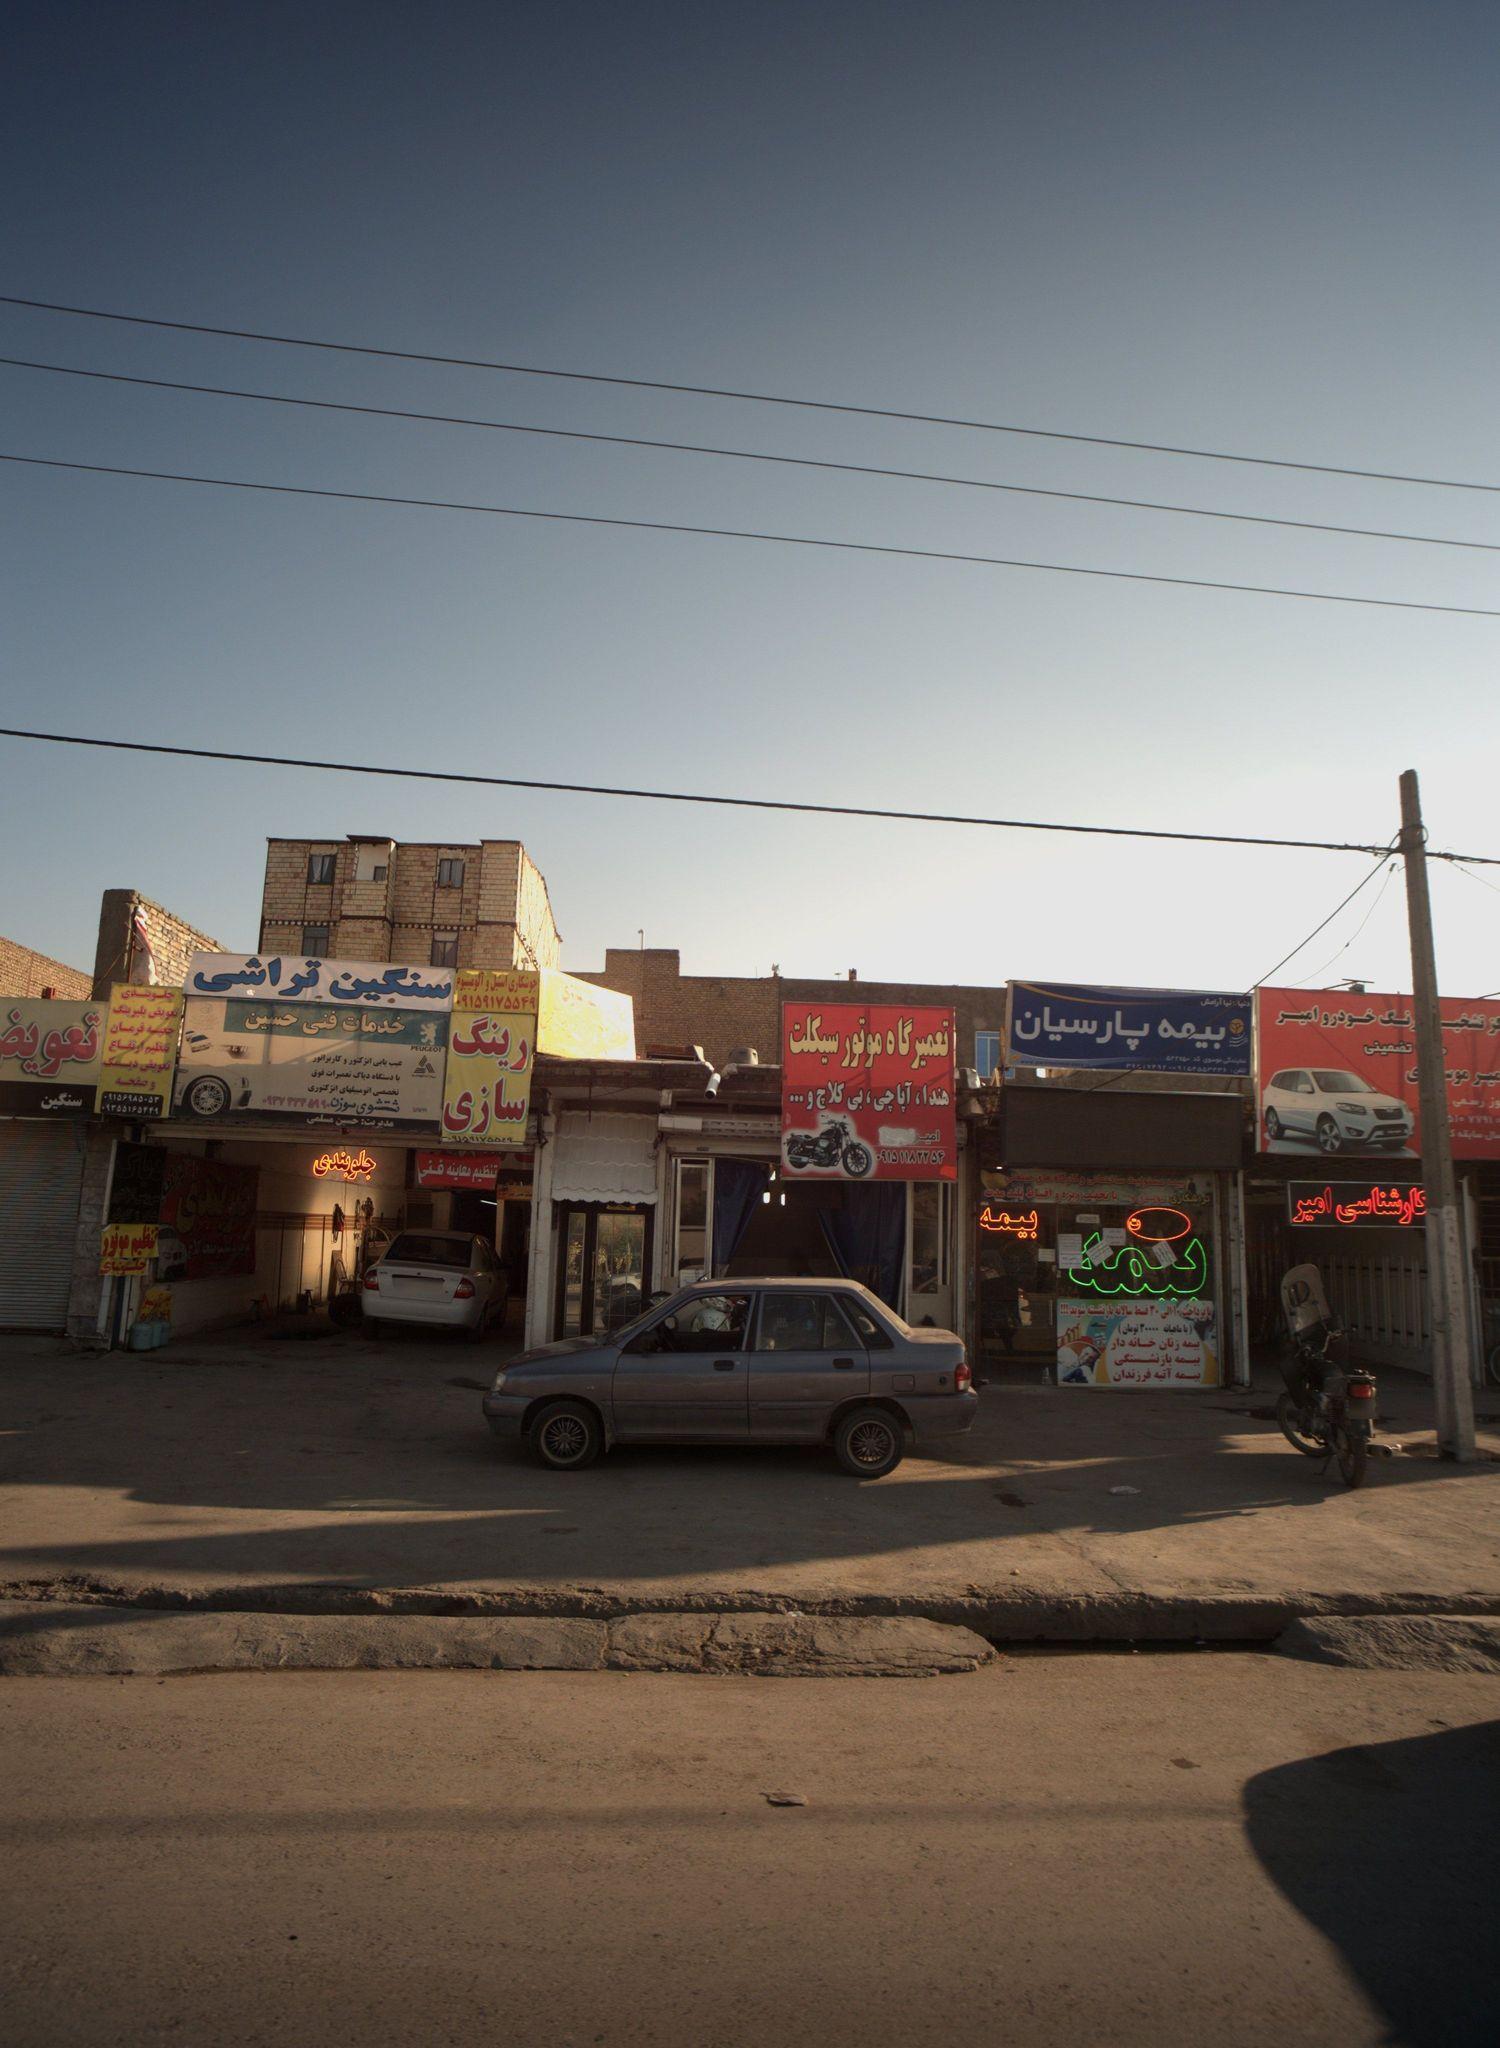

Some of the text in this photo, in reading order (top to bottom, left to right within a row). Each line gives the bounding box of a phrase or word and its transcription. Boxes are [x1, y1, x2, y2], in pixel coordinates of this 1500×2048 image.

[194, 957, 452, 1001] سنگین تراشی
[243, 1009, 406, 1036] خدمات فنی حسین
[1015, 1005, 1227, 1051] بیمه پارسیان
[1276, 1007, 1319, 1026] امیر
[1320, 1007, 1376, 1028] خودرو
[451, 1016, 530, 1072] رینگ
[789, 1013, 840, 1065] سیکلت
[841, 1016, 883, 1068] موتور
[1364, 1040, 1413, 1055] تضمینی
[40, 1092, 84, 1110] سنگین
[443, 1077, 527, 1135] سازی
[815, 1081, 846, 1111] کلاچ
[847, 1088, 864, 1112] بی
[312, 1149, 377, 1181] جلوبندی
[446, 1162, 472, 1181] معاینه
[471, 1164, 498, 1183] تنظیم
[1292, 1186, 1333, 1223] امیر
[979, 1206, 1038, 1239] بیمه
[1174, 1354, 1201, 1365] بیمه
[1174, 1370, 1201, 1381] بیمه
